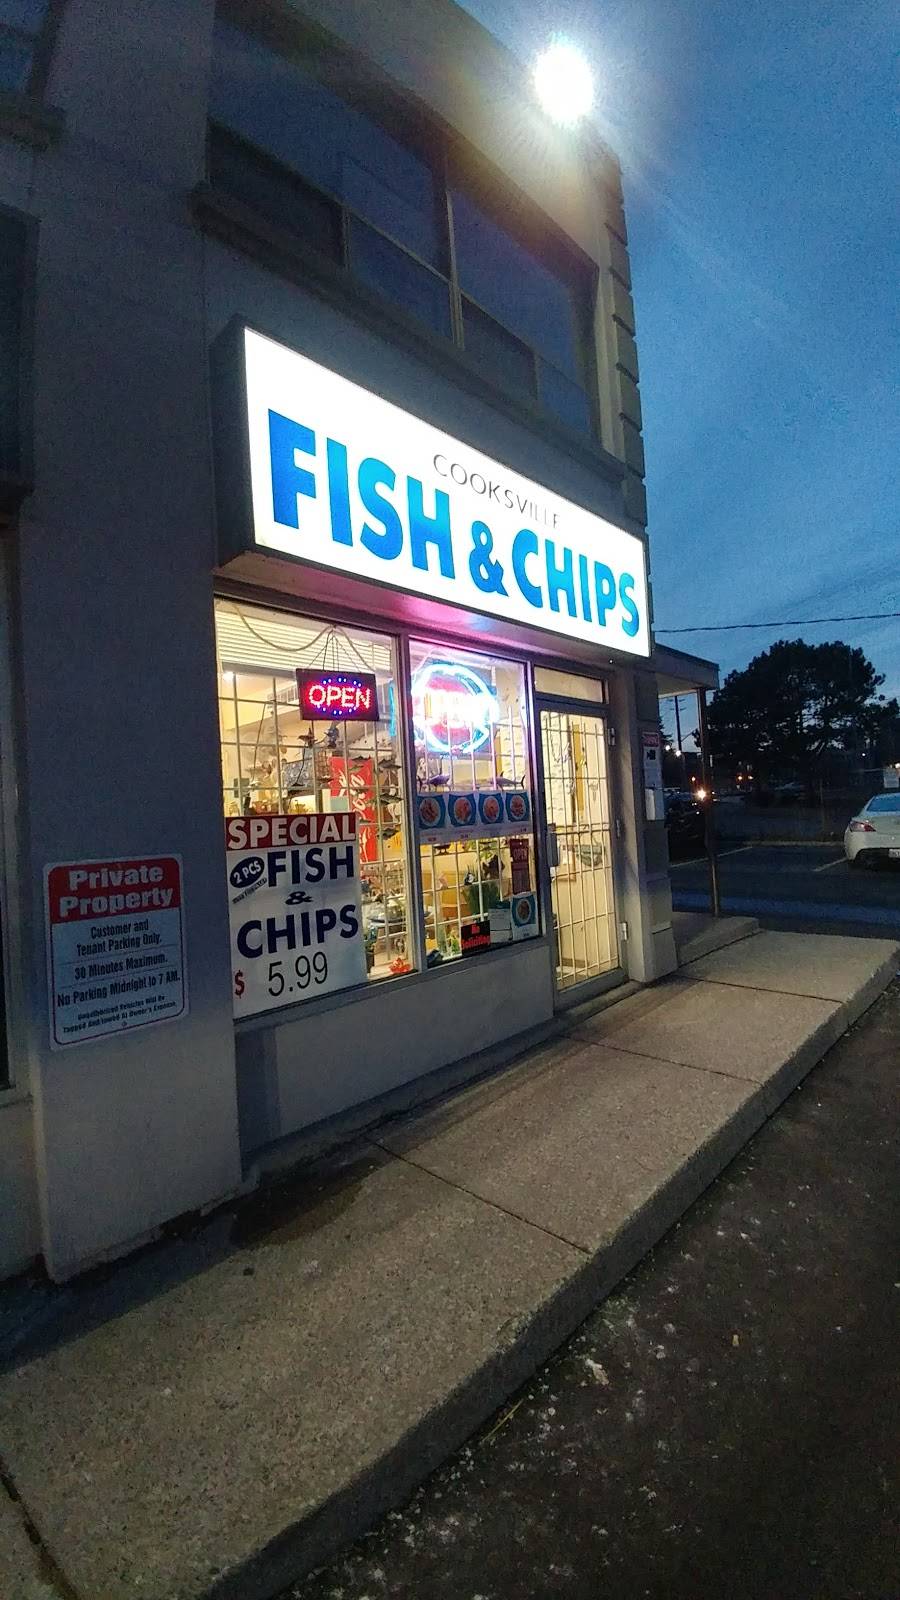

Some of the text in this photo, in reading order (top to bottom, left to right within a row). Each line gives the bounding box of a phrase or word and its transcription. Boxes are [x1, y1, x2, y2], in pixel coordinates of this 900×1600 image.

[433, 454, 560, 529] COOKSVILLE
[268, 408, 640, 638] FISH & CHIPS
[308, 684, 371, 709] OPEN
[228, 815, 356, 850] SPECIAL
[68, 865, 164, 891] Private
[233, 860, 262, 884] 2 PCS
[267, 845, 355, 888] FISH
[59, 887, 174, 918] Property
[285, 890, 313, 906] &
[76, 932, 162, 957] Tenant Parking Only.
[91, 919, 149, 939] Customer and
[237, 904, 359, 959] CHIPS
[74, 954, 168, 980] 30 Minutes Maximum.
[234, 951, 328, 999] $ 5.99
[57, 993, 71, 1007] No
[73, 987, 107, 1004] Parking
[110, 976, 147, 995] Midnight
[148, 975, 156, 986] to
[158, 973, 164, 984] 7
